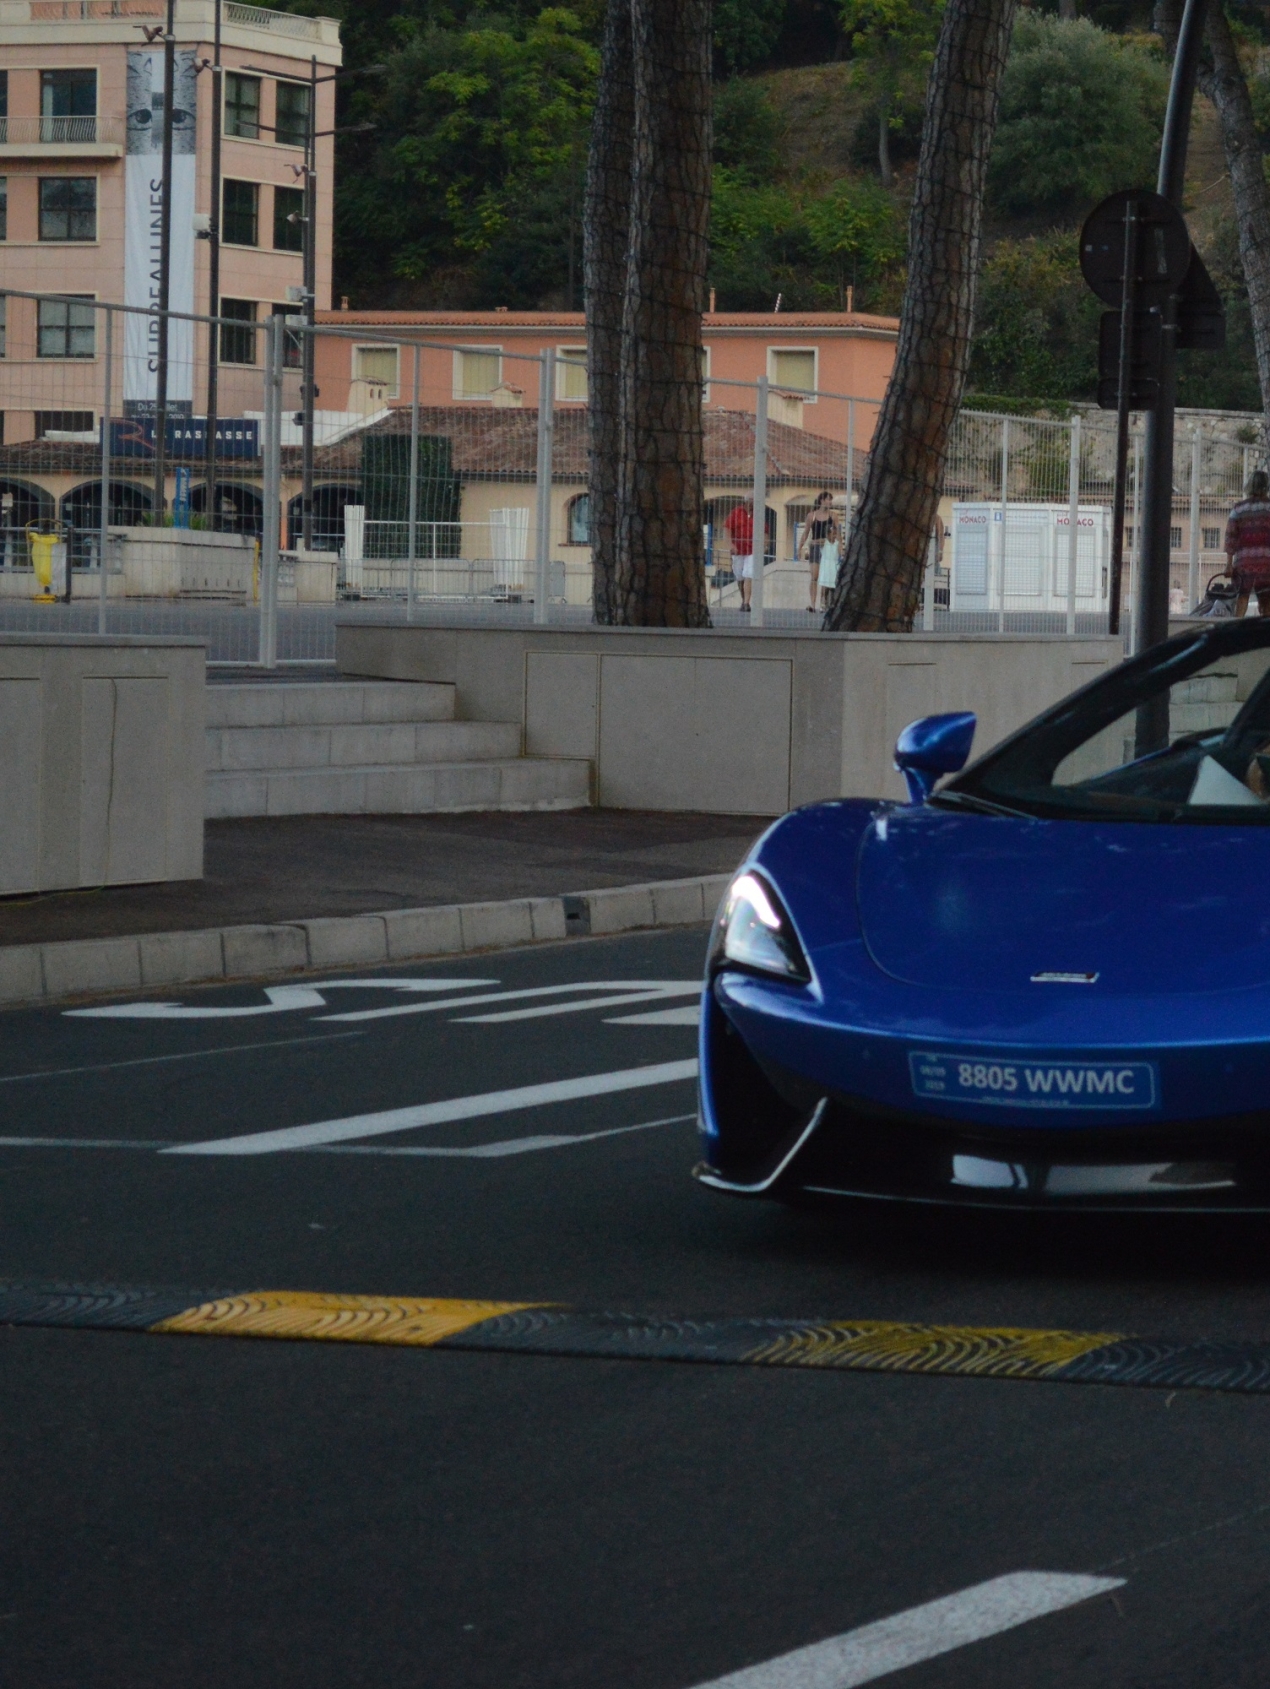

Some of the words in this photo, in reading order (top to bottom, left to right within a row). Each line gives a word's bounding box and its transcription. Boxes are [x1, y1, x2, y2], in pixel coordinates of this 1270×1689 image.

[151, 430, 167, 439] L
[174, 430, 253, 440] RASASSE
[958, 515, 987, 524] MONACO
[1056, 517, 1094, 527] MOACO
[60, 977, 706, 1027] US
[958, 1063, 1018, 1091] 8805
[1024, 1068, 1135, 1094] WWMC
